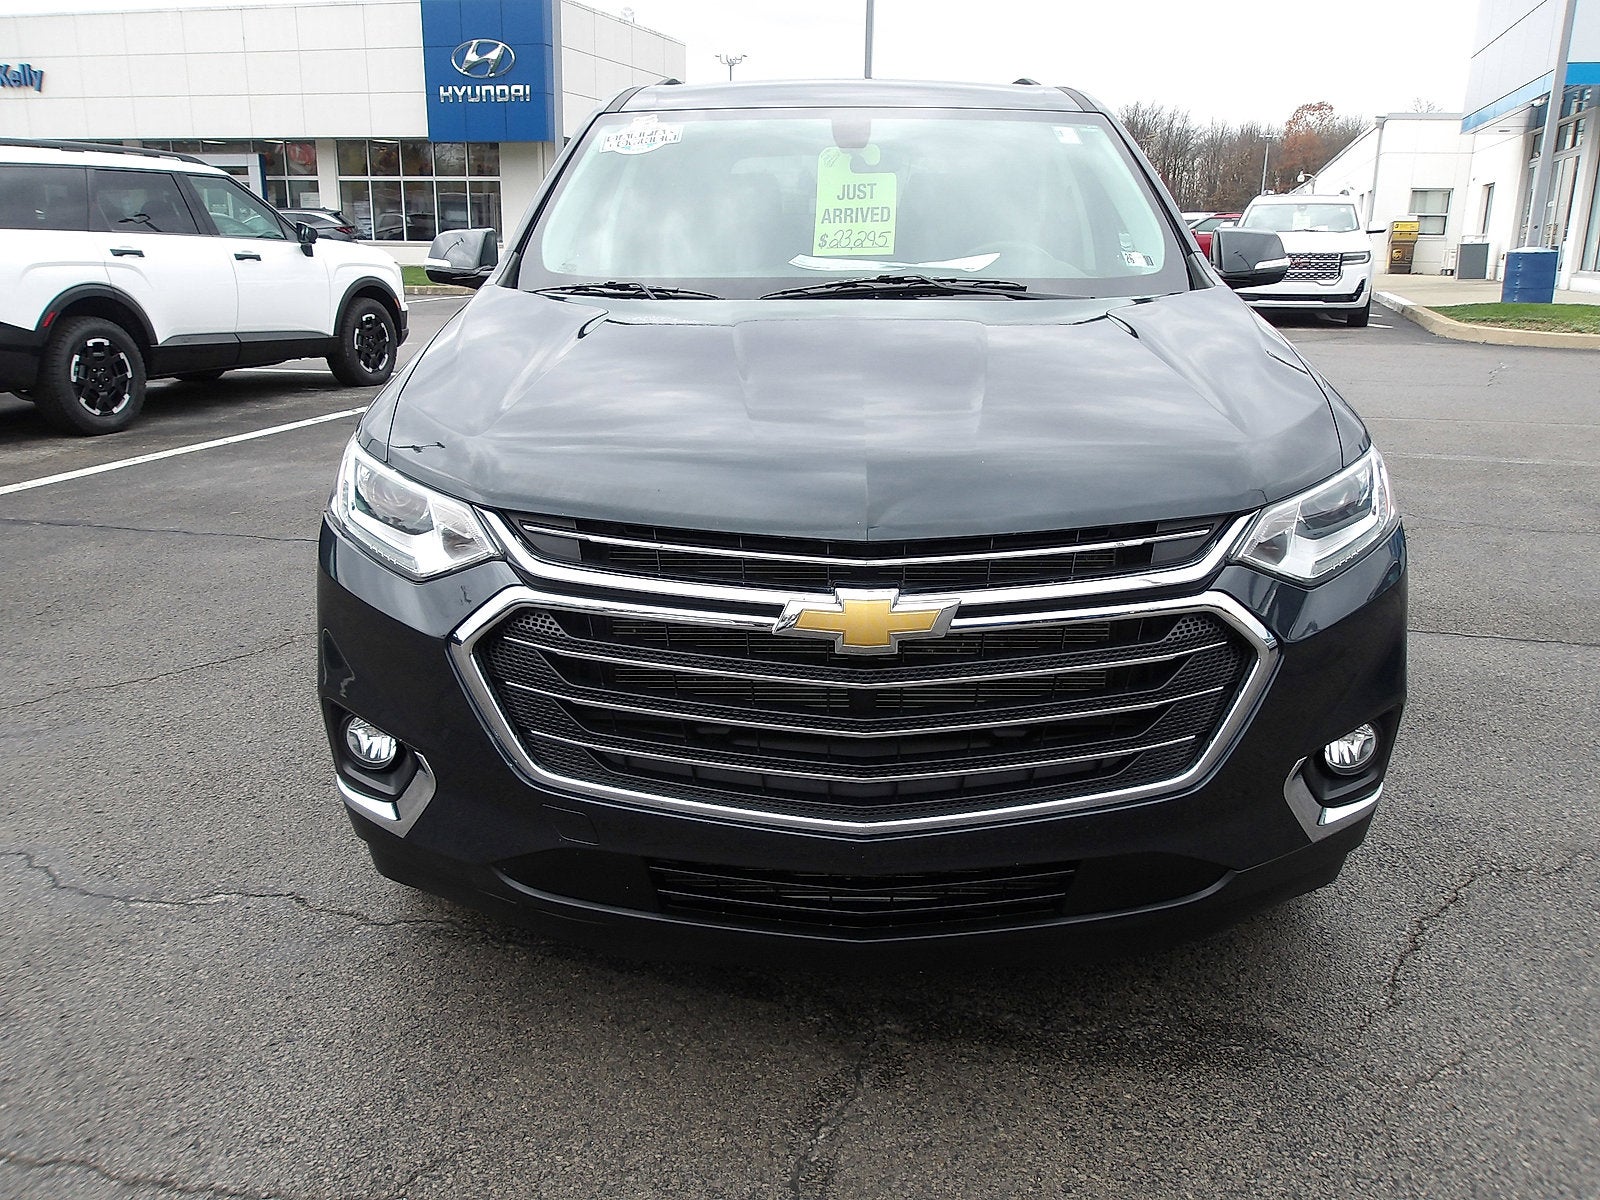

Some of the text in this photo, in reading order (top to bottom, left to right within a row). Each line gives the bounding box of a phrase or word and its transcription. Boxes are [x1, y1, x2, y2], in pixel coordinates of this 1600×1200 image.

[0, 64, 44, 92] Kelly
[439, 84, 531, 103] HYUNDAI
[837, 183, 877, 201] JUST
[820, 206, 891, 224] ARRIVED
